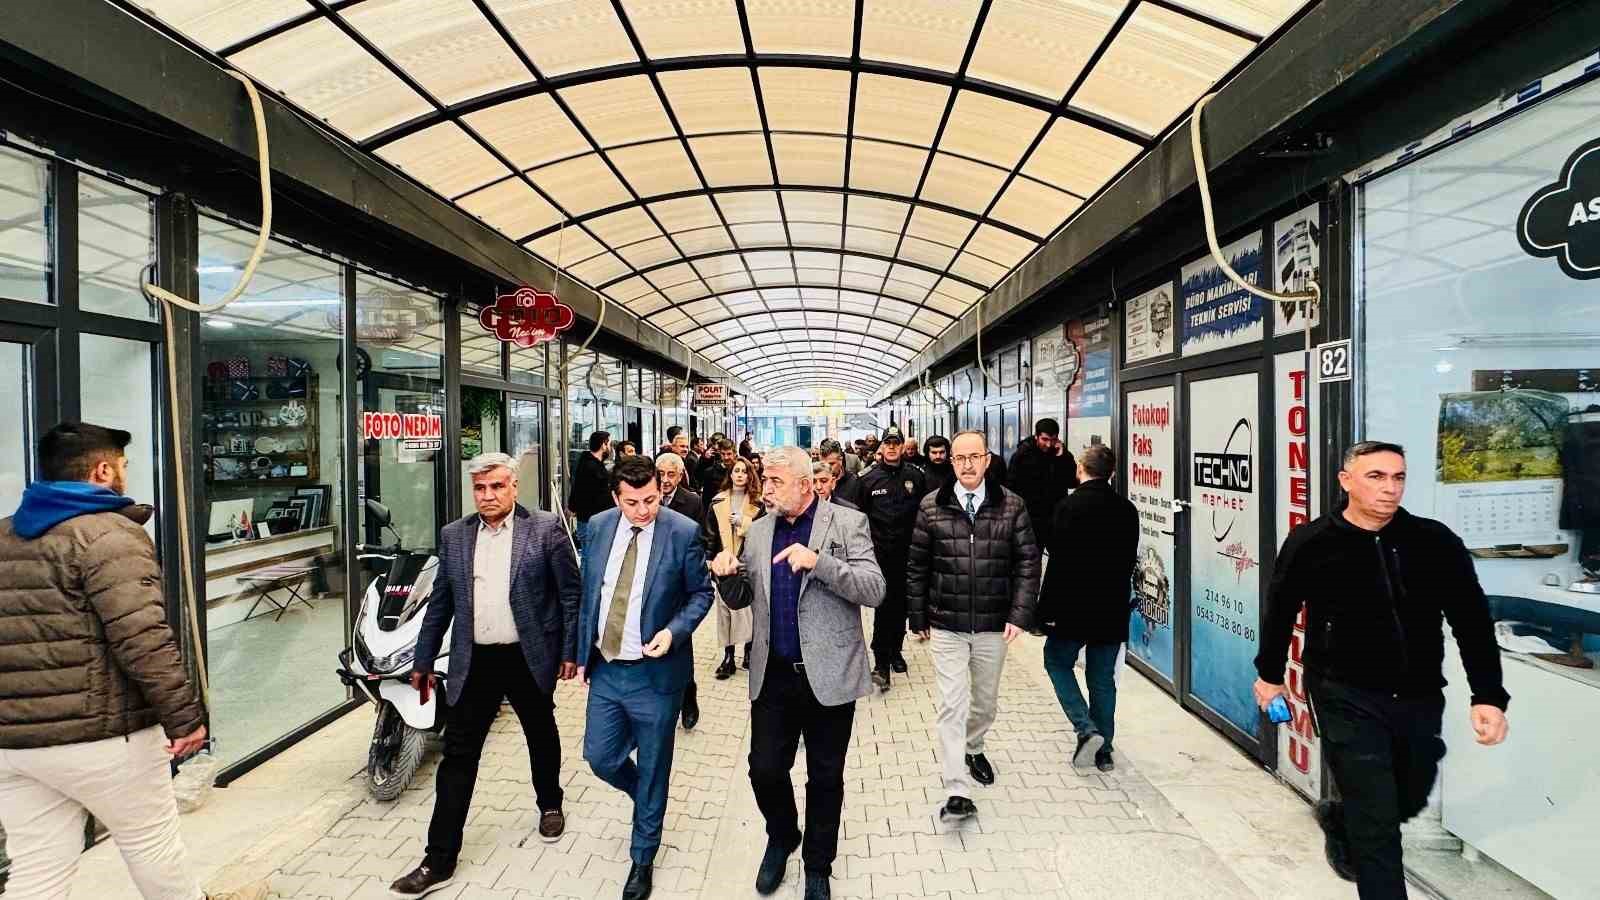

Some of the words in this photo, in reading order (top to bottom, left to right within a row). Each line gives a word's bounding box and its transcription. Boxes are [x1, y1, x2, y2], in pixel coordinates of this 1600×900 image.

[1185, 291, 1205, 310] BÜRO
[1190, 305, 1216, 327] TEKNİK
[1217, 292, 1252, 320] SERVİSİ
[1321, 347, 1347, 376] 82
[363, 411, 402, 440] FOTO
[403, 407, 442, 439] NEDİM
[1132, 402, 1170, 432] Fotokopi
[1132, 432, 1153, 457] Faks
[1132, 462, 1162, 489] Printer
[1194, 456, 1251, 489] TECHNO
[1205, 589, 1219, 604] 214
[1221, 594, 1231, 609] 96
[1234, 599, 1243, 615] 10
[1216, 613, 1230, 630] 738
[1231, 620, 1242, 636] 80
[1244, 626, 1255, 642] 80
